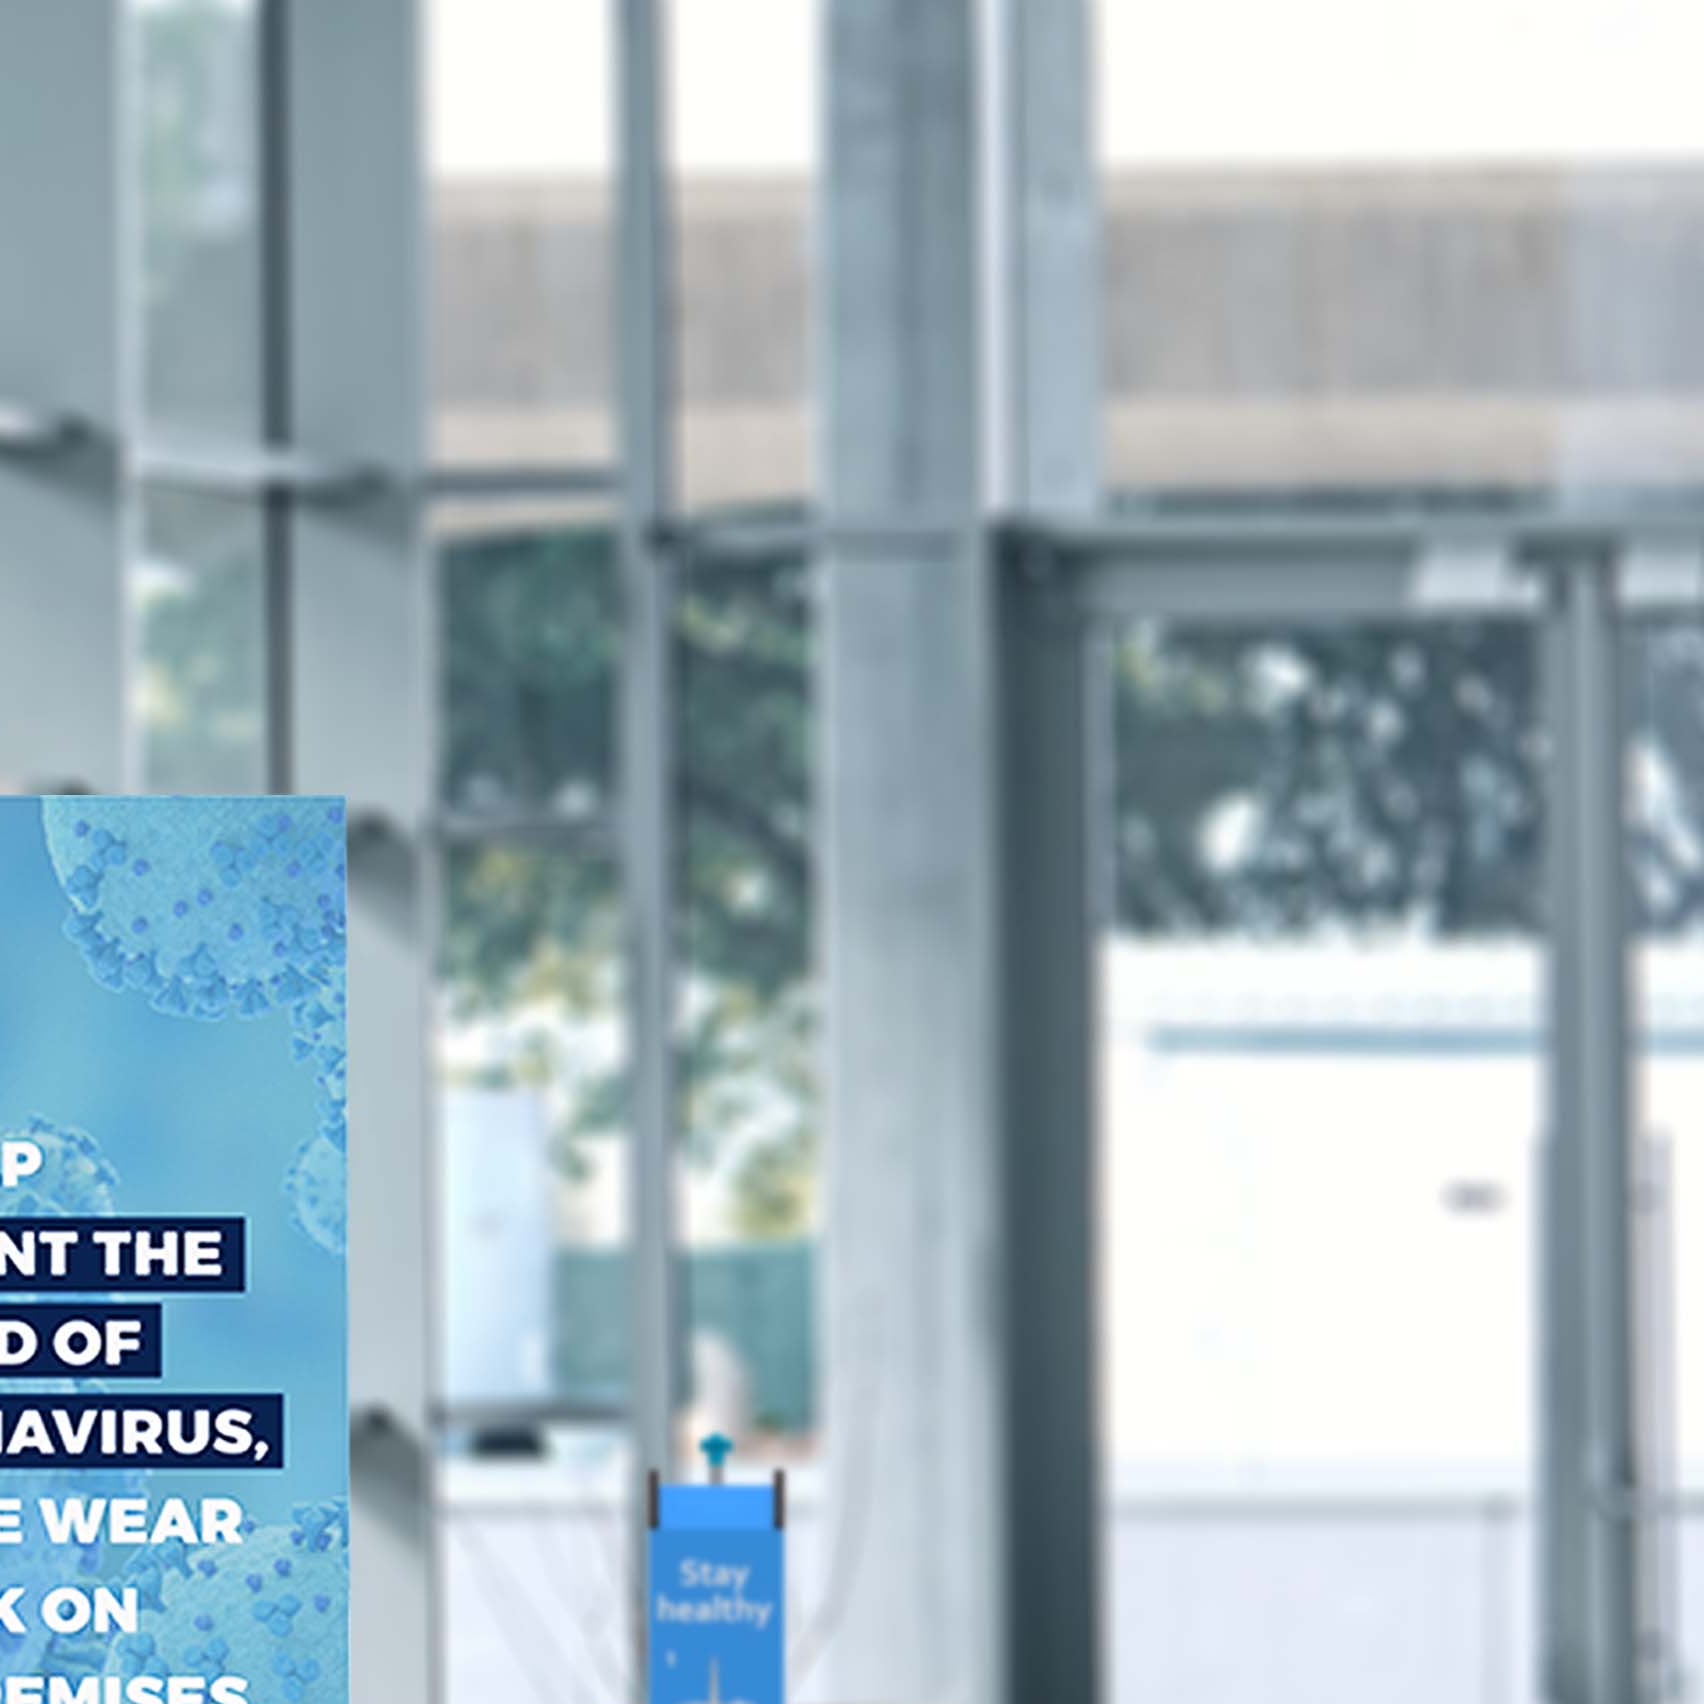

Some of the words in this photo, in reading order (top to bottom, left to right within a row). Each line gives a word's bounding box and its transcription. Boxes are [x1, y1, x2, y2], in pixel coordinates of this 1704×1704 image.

[93, 1231, 222, 1276] THE
[54, 1320, 142, 1366] OF
[39, 1498, 243, 1545] WEAR
[680, 1557, 751, 1593] Stay
[42, 1587, 138, 1634] ON
[656, 1593, 773, 1632] healthy
